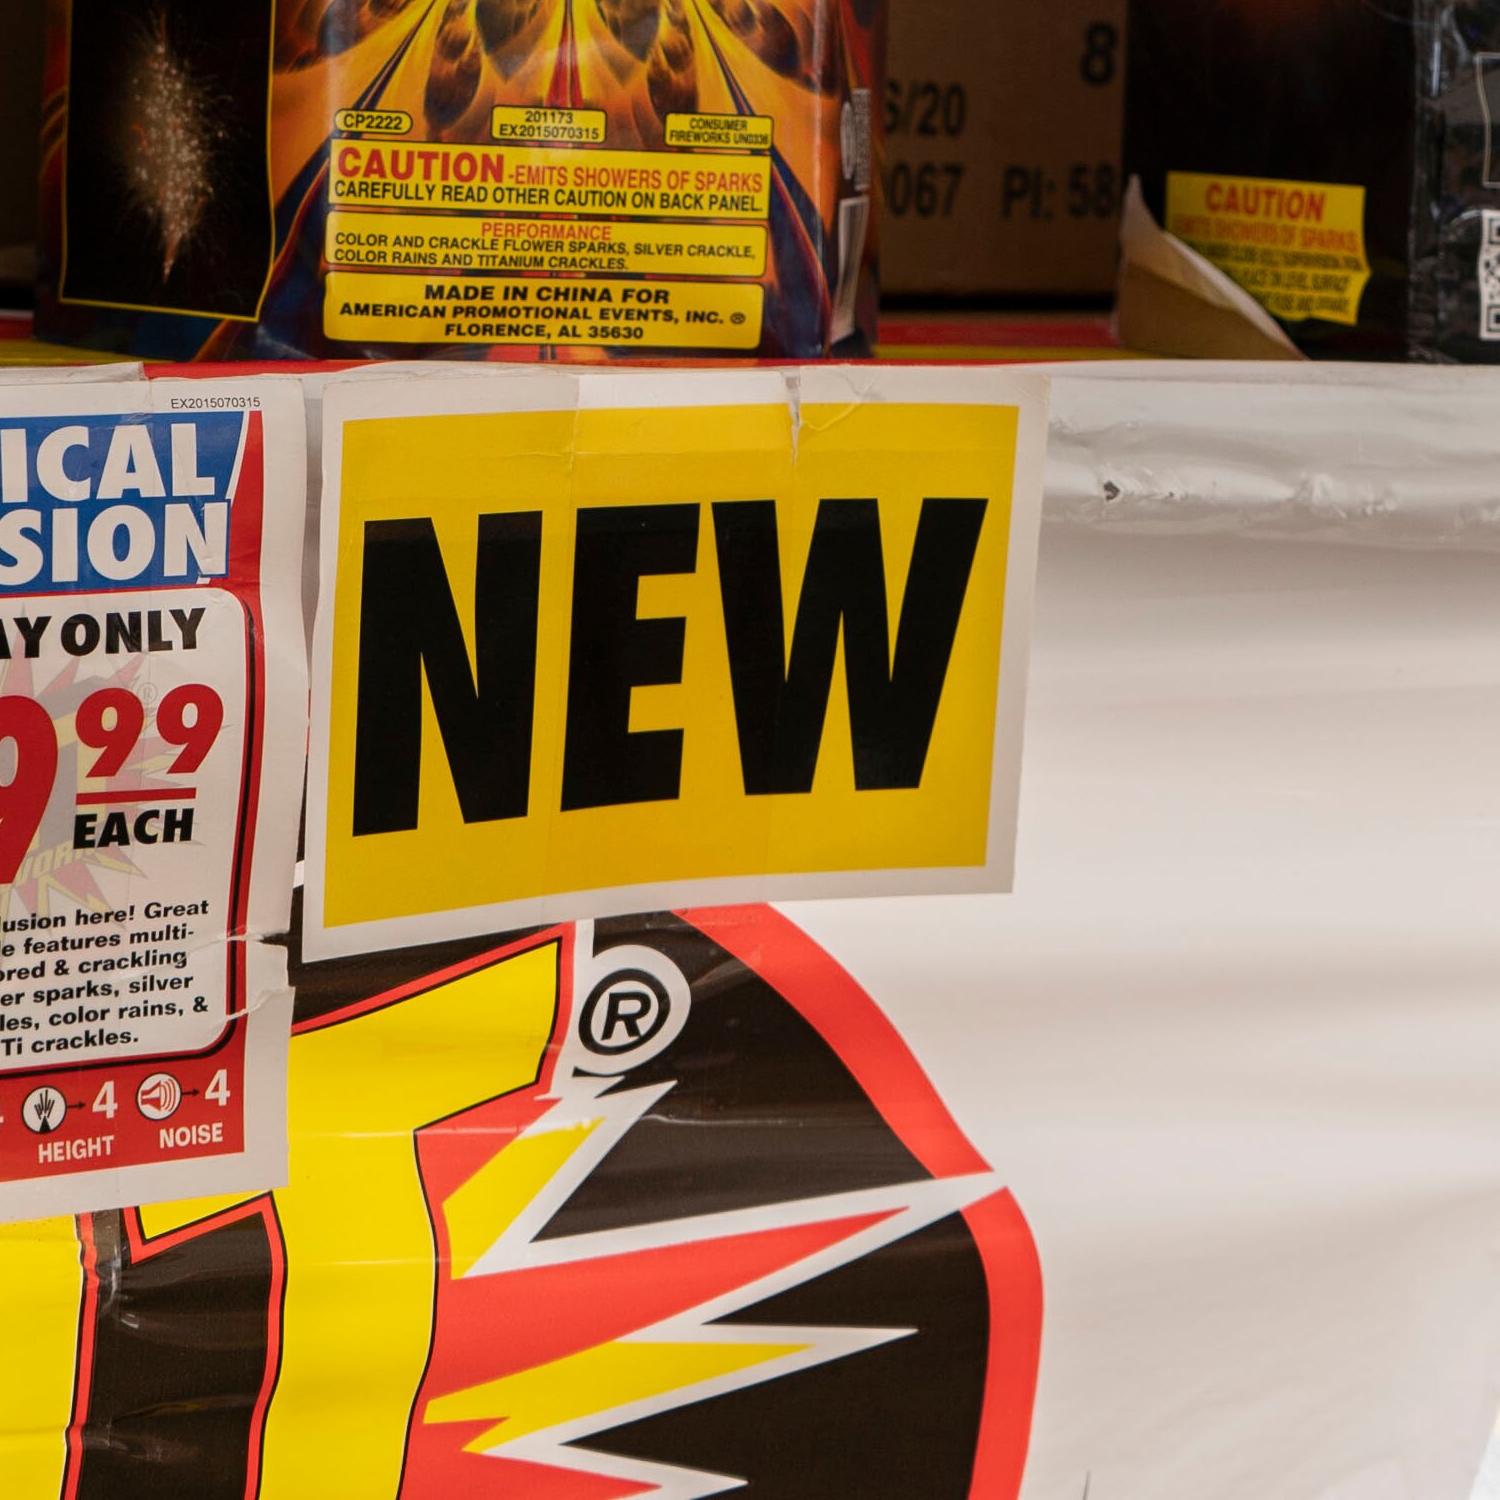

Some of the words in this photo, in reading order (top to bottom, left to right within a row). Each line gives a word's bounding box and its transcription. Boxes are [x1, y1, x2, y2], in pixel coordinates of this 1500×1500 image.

[343, 113, 403, 131] CP2222
[499, 124, 599, 140] EX2015070315
[525, 110, 573, 124] 201173
[337, 146, 505, 184] CAUTION
[573, 167, 662, 190] SHOWERS
[667, 170, 691, 190] OF
[695, 171, 763, 193] SPARKS
[334, 180, 435, 201] CAREFULLY
[441, 185, 488, 202] READ
[492, 187, 549, 205] OTHER
[554, 189, 627, 208] CAUTION
[631, 191, 655, 208] ON
[659, 192, 703, 210] BACK
[708, 194, 763, 211] PANEL.
[1205, 182, 1327, 222] CAUTION
[481, 222, 612, 241] PERFORMANCE
[424, 285, 495, 301] MADE
[502, 286, 528, 301] IN
[535, 286, 613, 303] CHINA
[621, 288, 670, 304] FOR
[339, 302, 446, 318] AMERICAN
[452, 305, 592, 320] PROMOTIONAL
[599, 308, 679, 324] EVENTS,
[685, 310, 724, 324] INC.
[444, 323, 552, 339] FLORENCE,
[557, 324, 581, 338] AL
[587, 325, 644, 339] 35630
[171, 396, 261, 410] EX2015070315
[59, 606, 206, 657] ONLY
[352, 496, 989, 839] NEW
[71, 807, 196, 850] EACH
[75, 905, 136, 926] here!
[143, 899, 210, 919] Great
[23, 934, 121, 955] features
[128, 923, 195, 944] multi-
[53, 958, 70, 976] &
[77, 949, 188, 974] crackling
[32, 980, 120, 1005] sparks,
[127, 973, 194, 995] silver
[48, 1005, 111, 1027] color
[117, 999, 185, 1019] rains,
[192, 995, 209, 1012] &
[0, 1037, 23, 1056] Ti
[30, 1027, 139, 1054] crackles.
[91, 1080, 119, 1120] 4
[204, 1068, 231, 1107] 4
[37, 1135, 115, 1164] HEIGHT
[158, 1123, 224, 1149] NOISE
